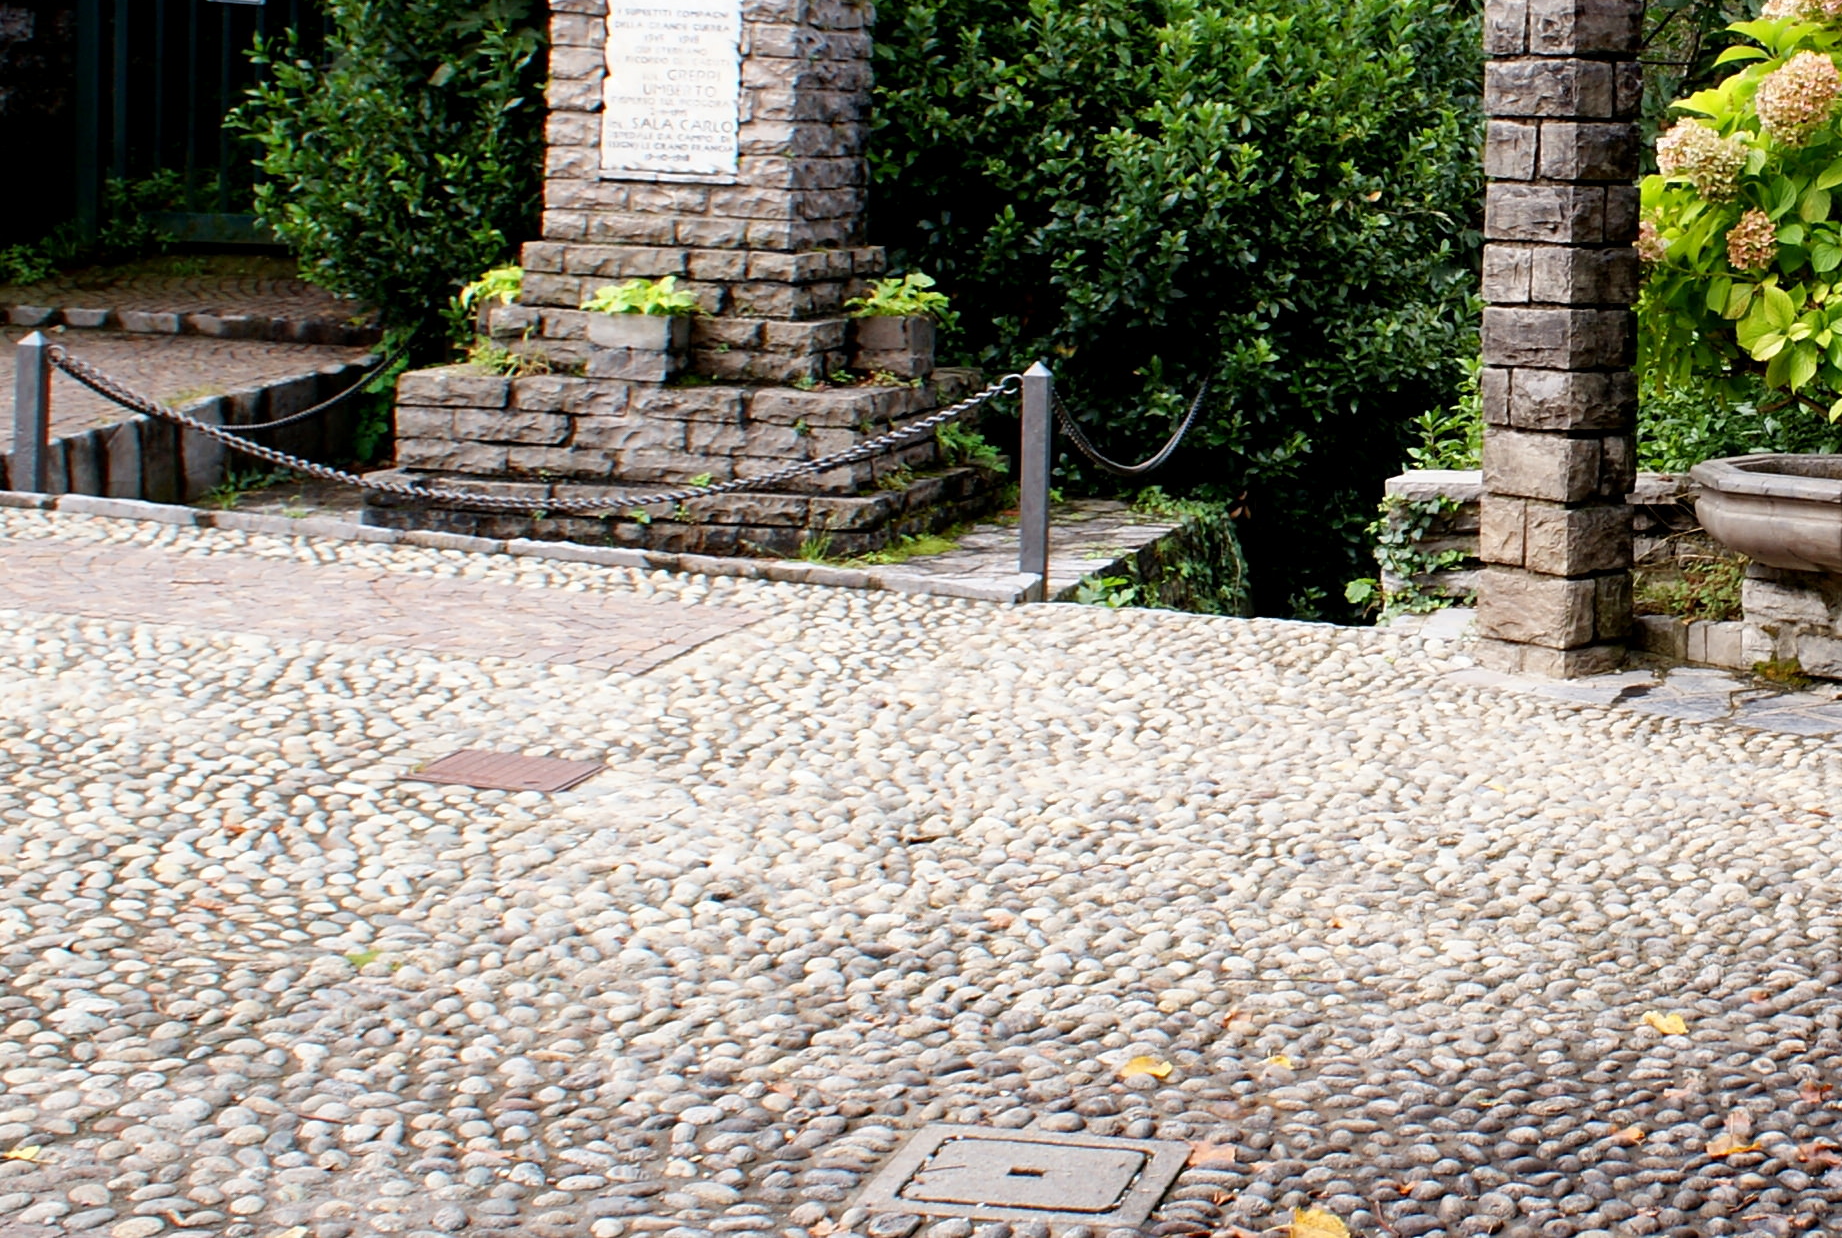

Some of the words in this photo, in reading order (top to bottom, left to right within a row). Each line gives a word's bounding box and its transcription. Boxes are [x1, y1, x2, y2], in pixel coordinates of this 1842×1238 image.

[667, 69, 721, 82] GREPPI
[643, 83, 717, 98] UMBERTO
[632, 117, 674, 130] SALA
[680, 119, 733, 133] CARLO
